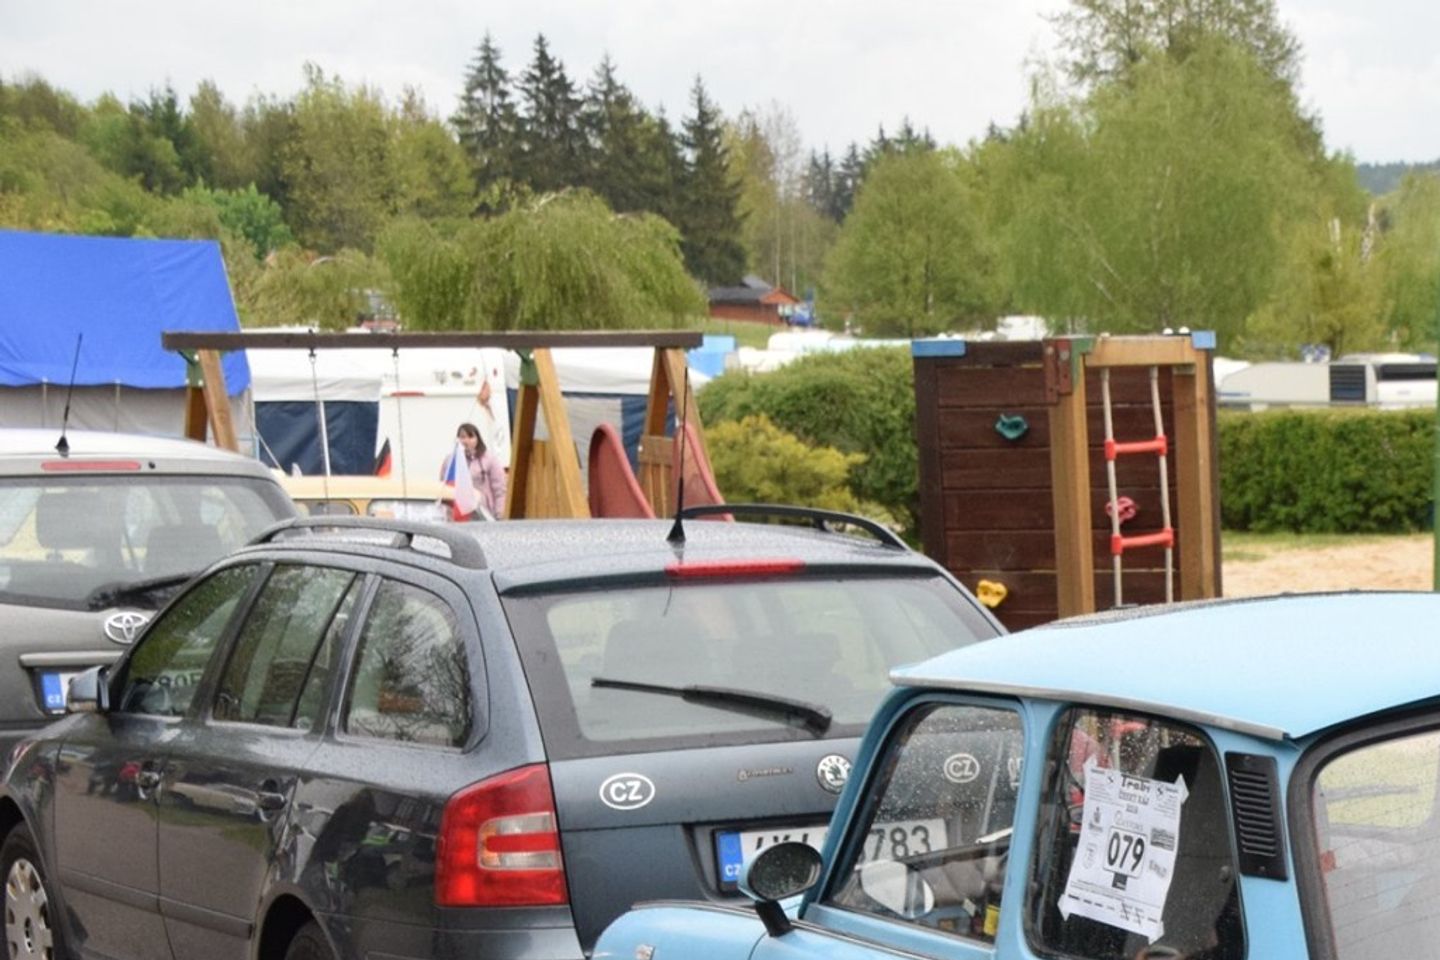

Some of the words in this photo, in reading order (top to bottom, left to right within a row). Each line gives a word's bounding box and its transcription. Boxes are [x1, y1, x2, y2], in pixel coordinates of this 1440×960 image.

[950, 760, 974, 778] CZ
[609, 781, 643, 803] CZ
[1107, 831, 1145, 872] 079
